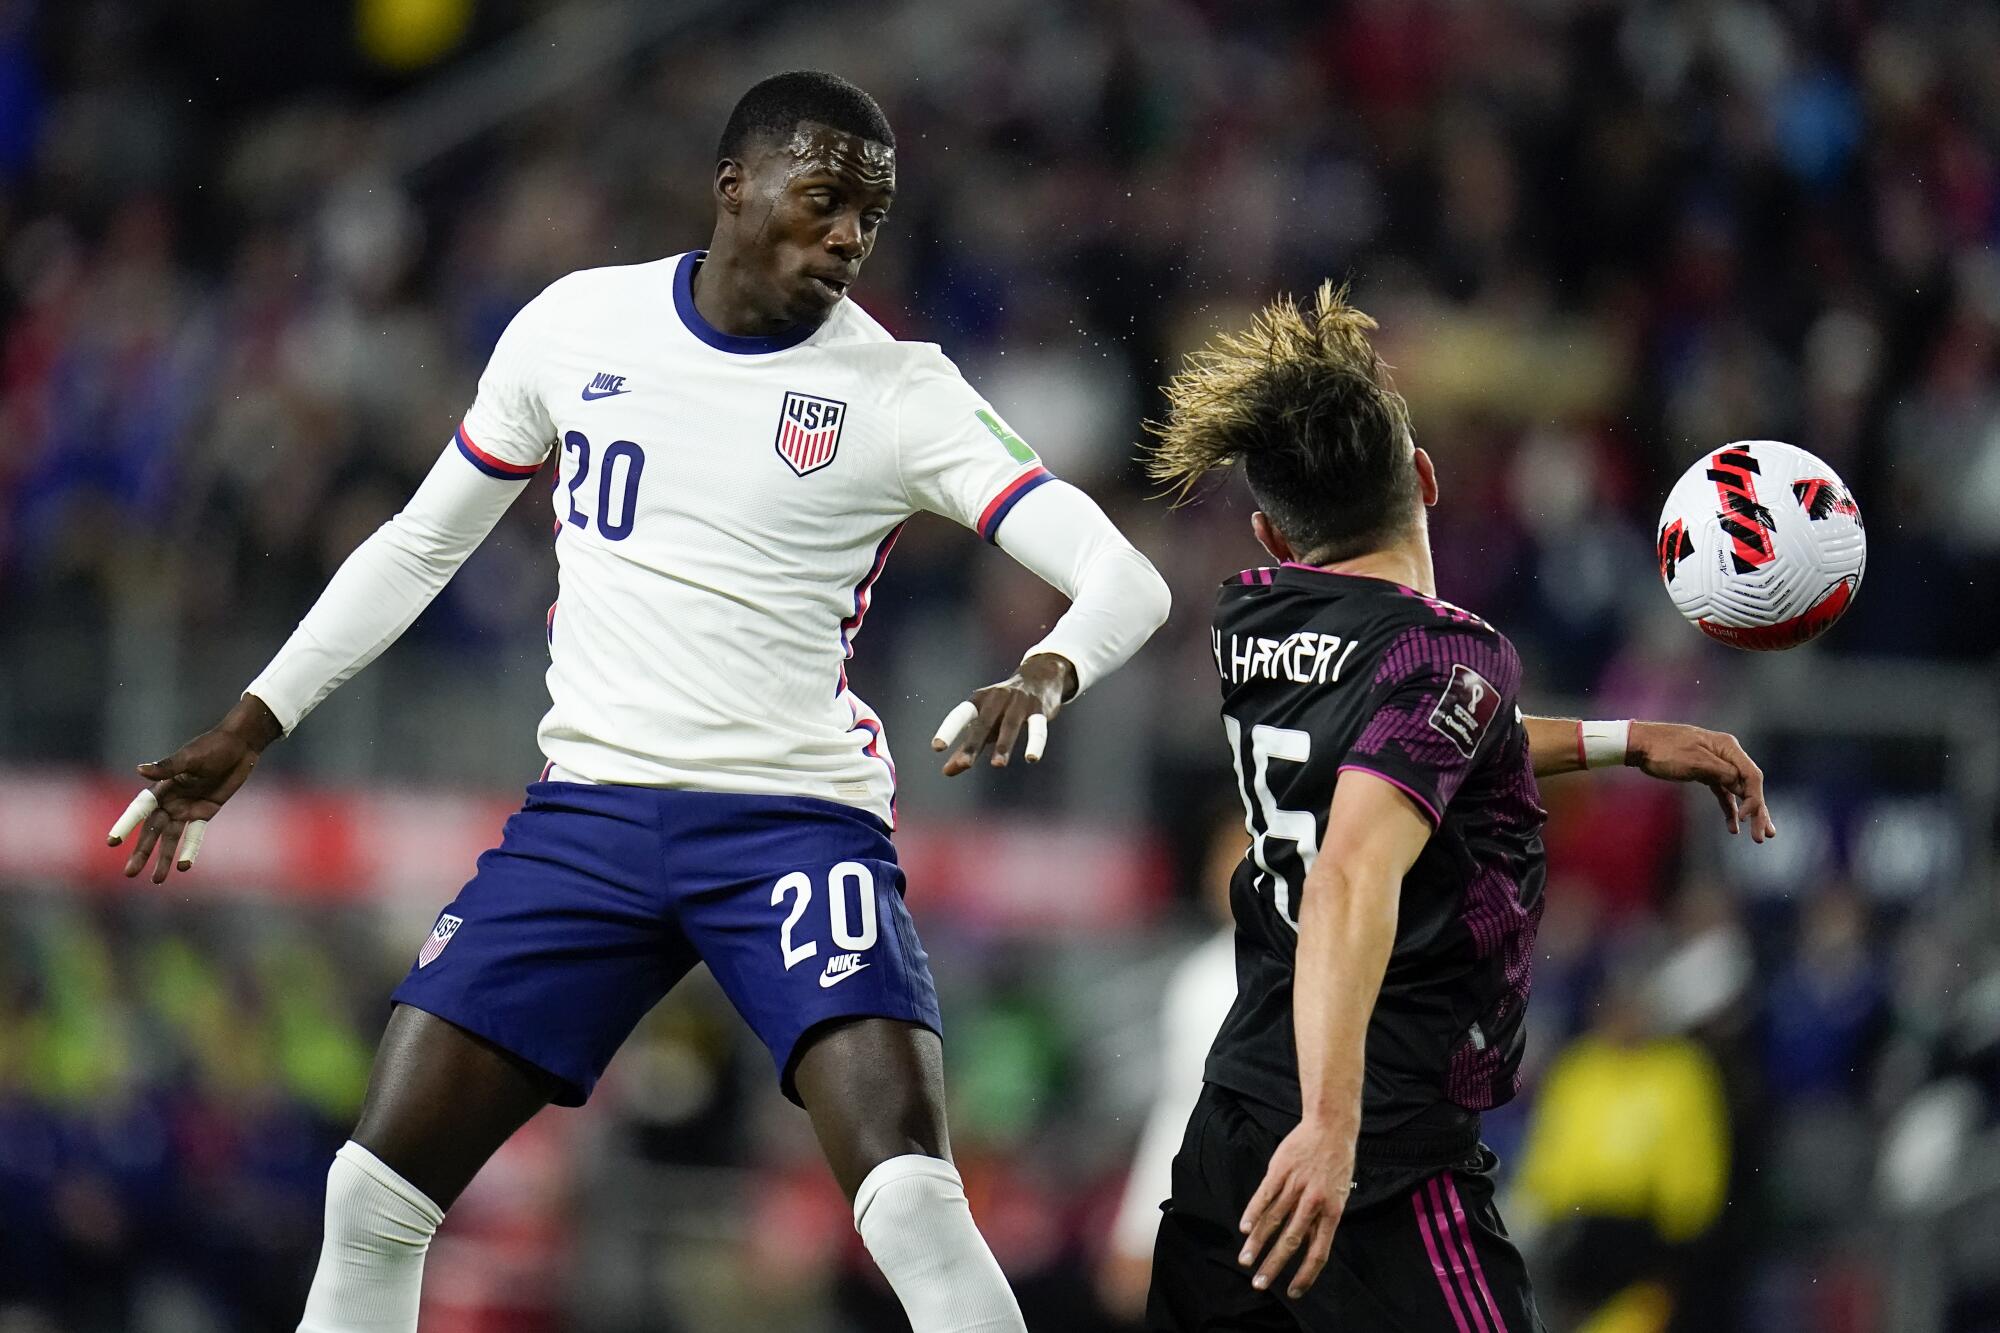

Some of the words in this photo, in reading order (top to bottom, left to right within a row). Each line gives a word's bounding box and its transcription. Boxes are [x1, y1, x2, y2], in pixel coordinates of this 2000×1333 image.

[590, 372, 626, 392] NIKE
[788, 398, 839, 430] USA
[564, 430, 646, 541] 20
[436, 917, 460, 938] USA
[770, 861, 878, 972] 20
[826, 953, 862, 974] NIKE
